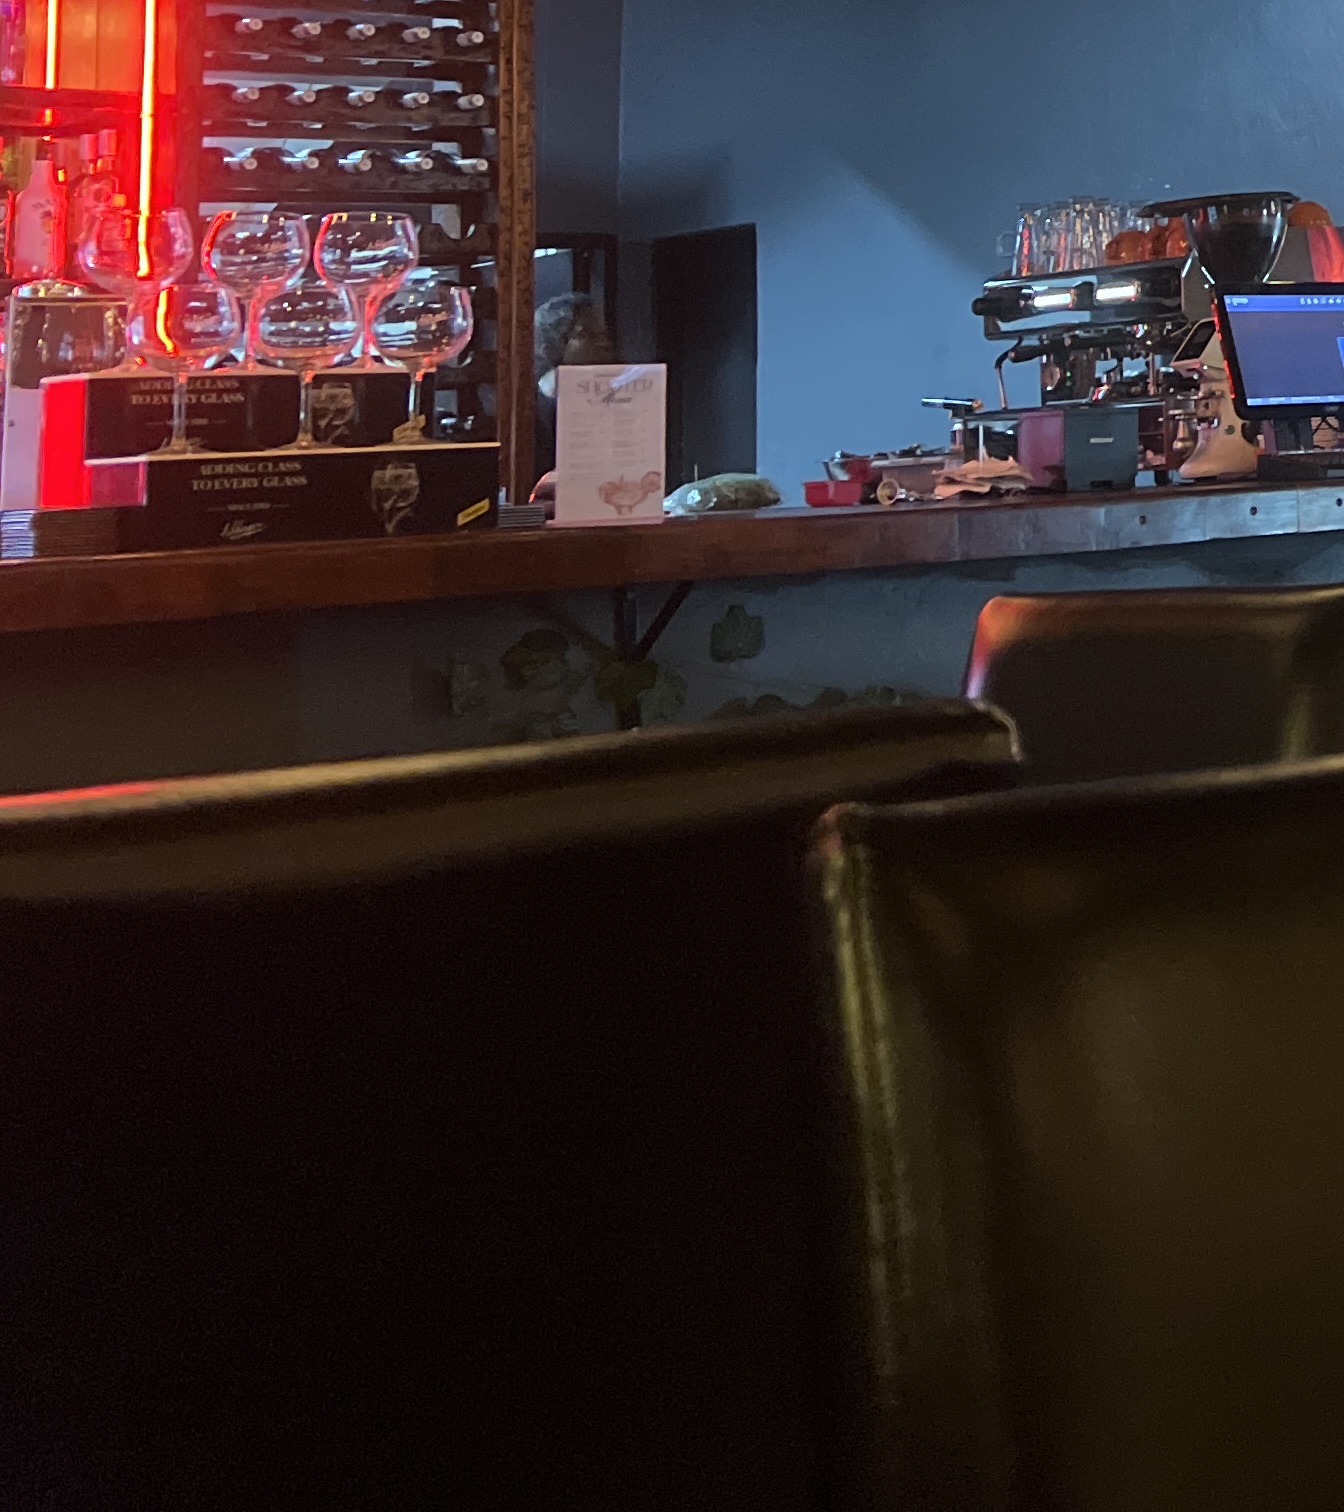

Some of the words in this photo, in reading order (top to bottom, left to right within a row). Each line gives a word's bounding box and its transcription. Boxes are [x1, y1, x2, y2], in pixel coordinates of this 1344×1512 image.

[200, 391, 246, 404] GLASS
[258, 460, 302, 473] CLASS
[192, 479, 211, 490] TO
[262, 476, 307, 487] GLASS
